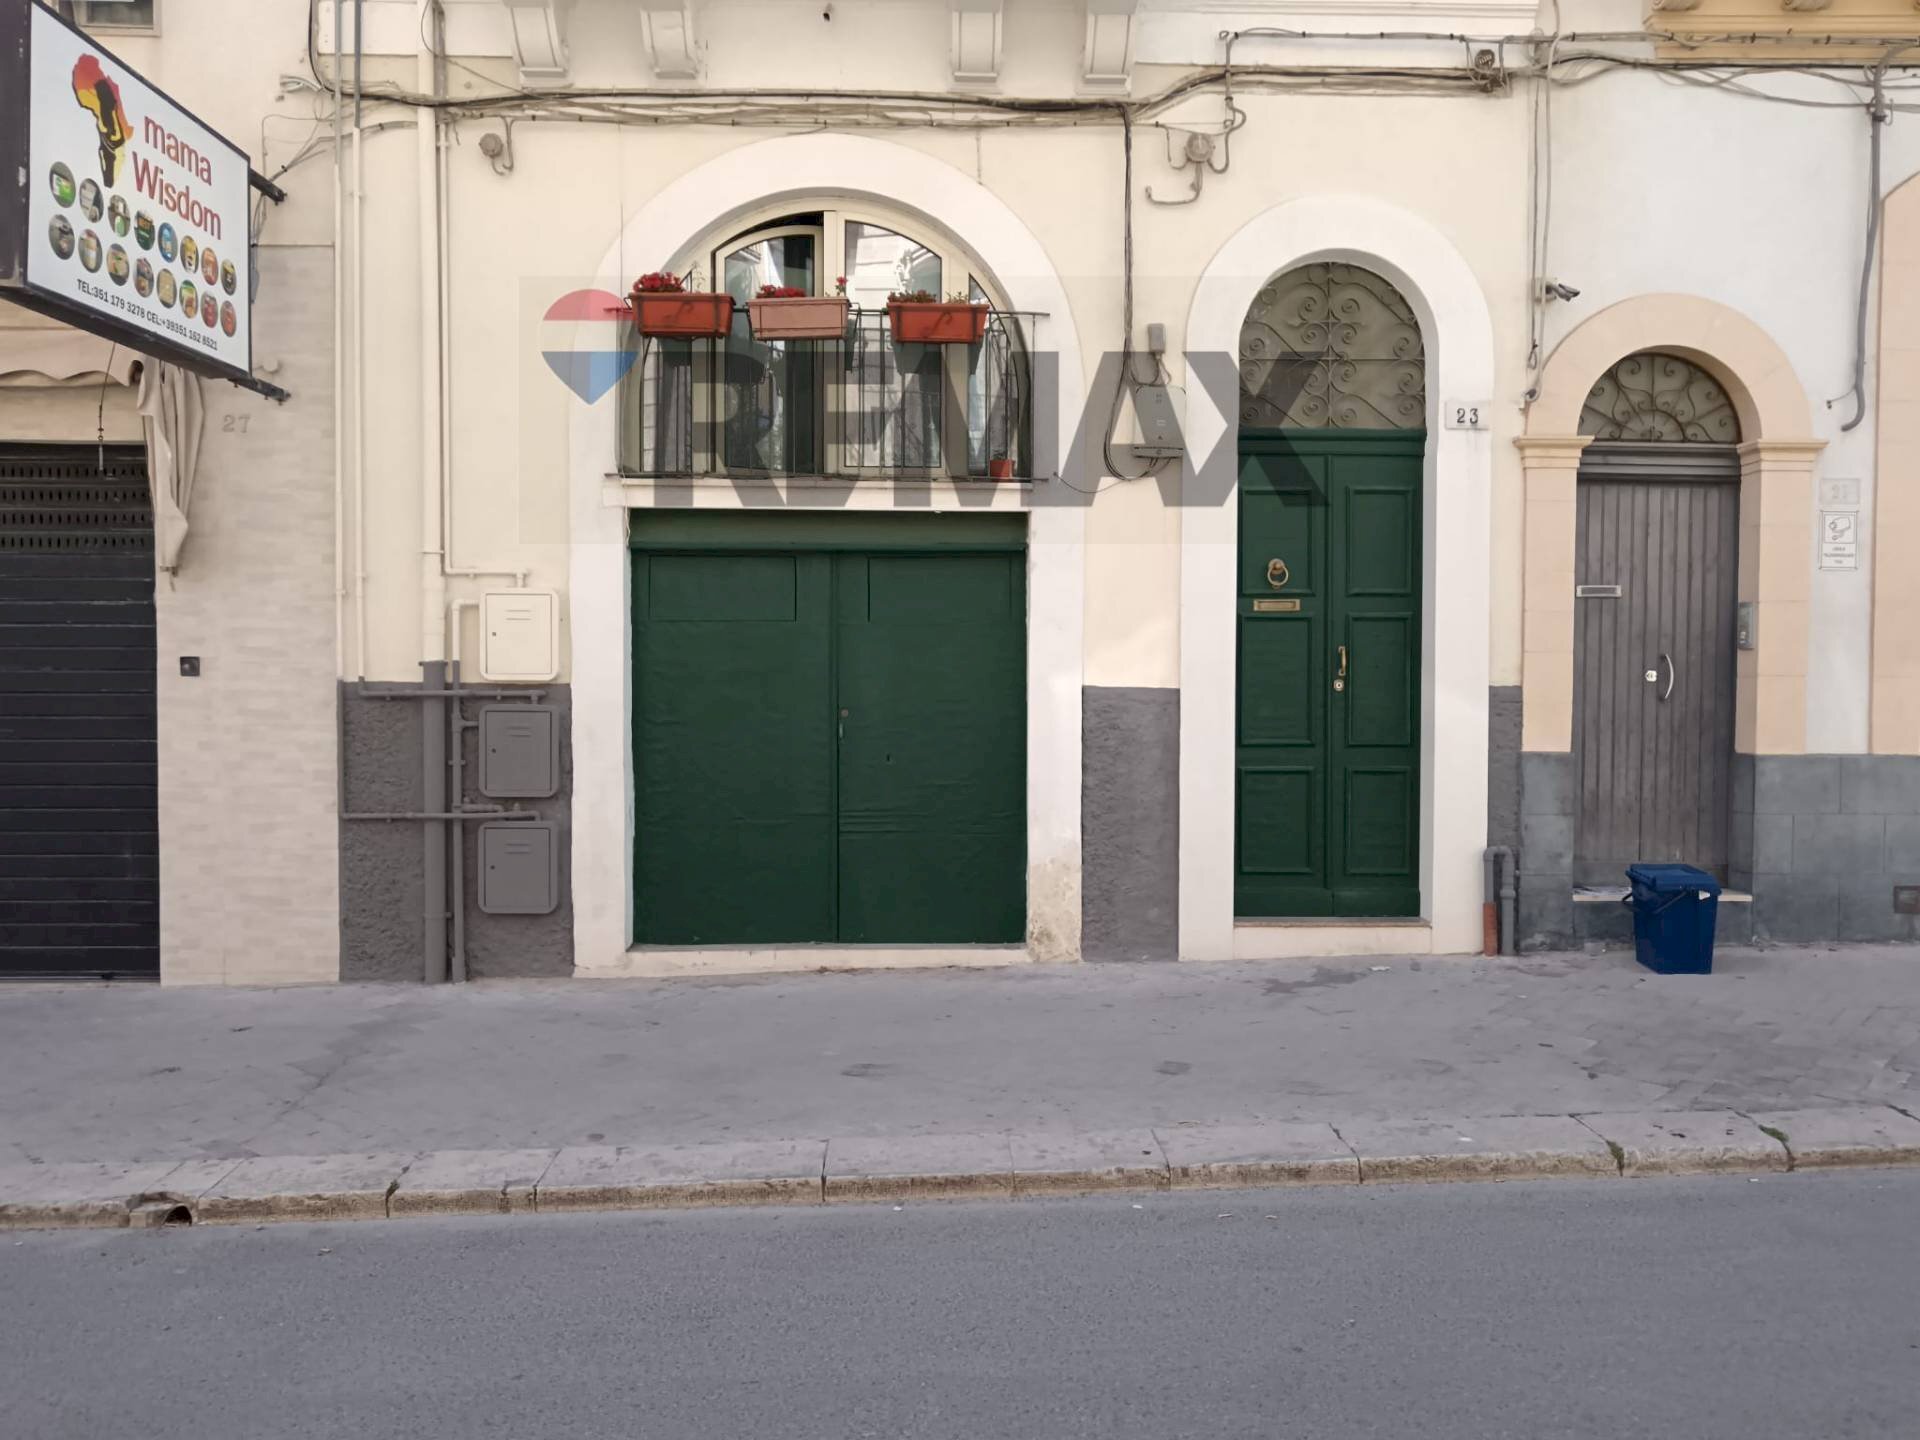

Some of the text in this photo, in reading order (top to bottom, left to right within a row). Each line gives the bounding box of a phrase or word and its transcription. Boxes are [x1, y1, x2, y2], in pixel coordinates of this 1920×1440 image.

[144, 115, 212, 186] mama
[132, 150, 221, 240] Wisdom
[77, 278, 109, 303] TEL:351
[110, 294, 125, 309] 179
[127, 301, 145, 318] 3278
[222, 413, 251, 434] 27
[1456, 407, 1479, 425] 23
